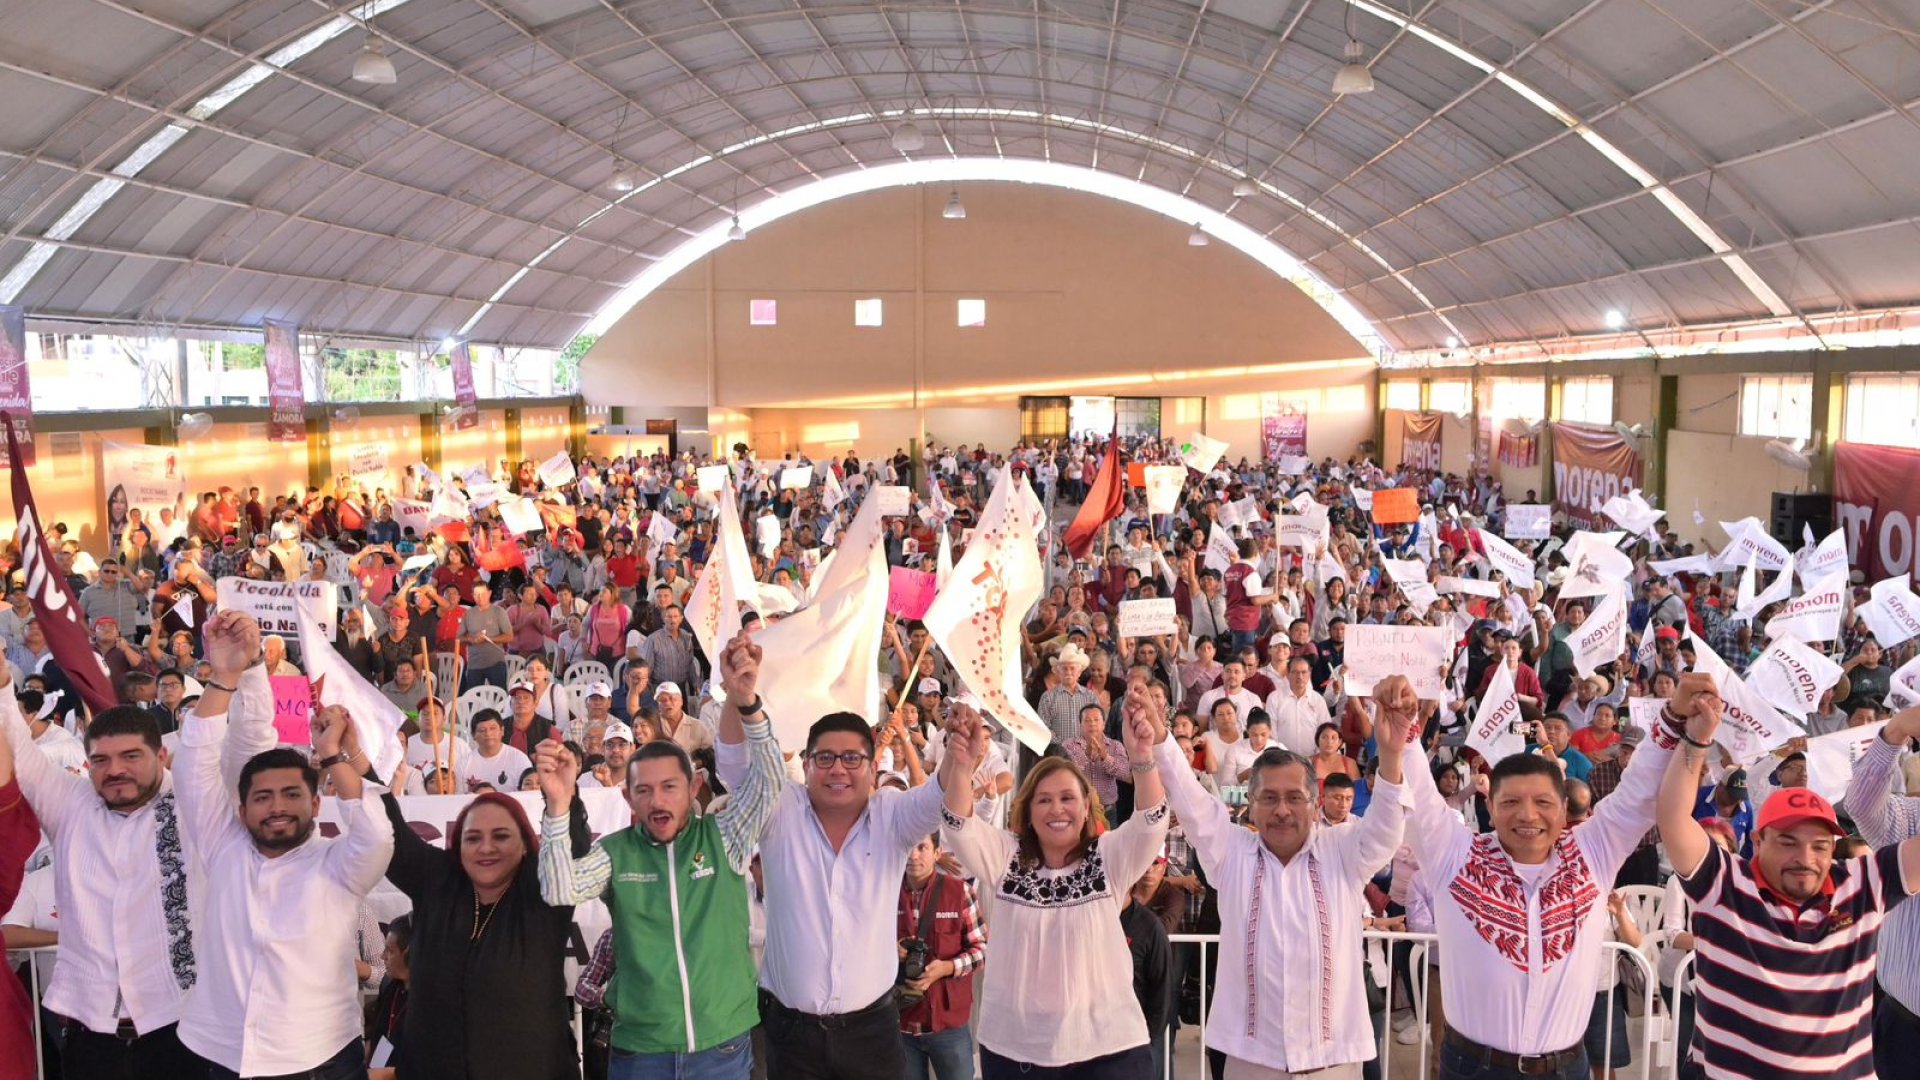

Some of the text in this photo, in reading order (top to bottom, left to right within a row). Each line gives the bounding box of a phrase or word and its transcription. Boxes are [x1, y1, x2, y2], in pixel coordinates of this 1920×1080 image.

[272, 412, 305, 424] ZAMORA
[275, 603, 293, 612] con
[1774, 649, 1817, 703] morena
[1787, 793, 1824, 813] CA
